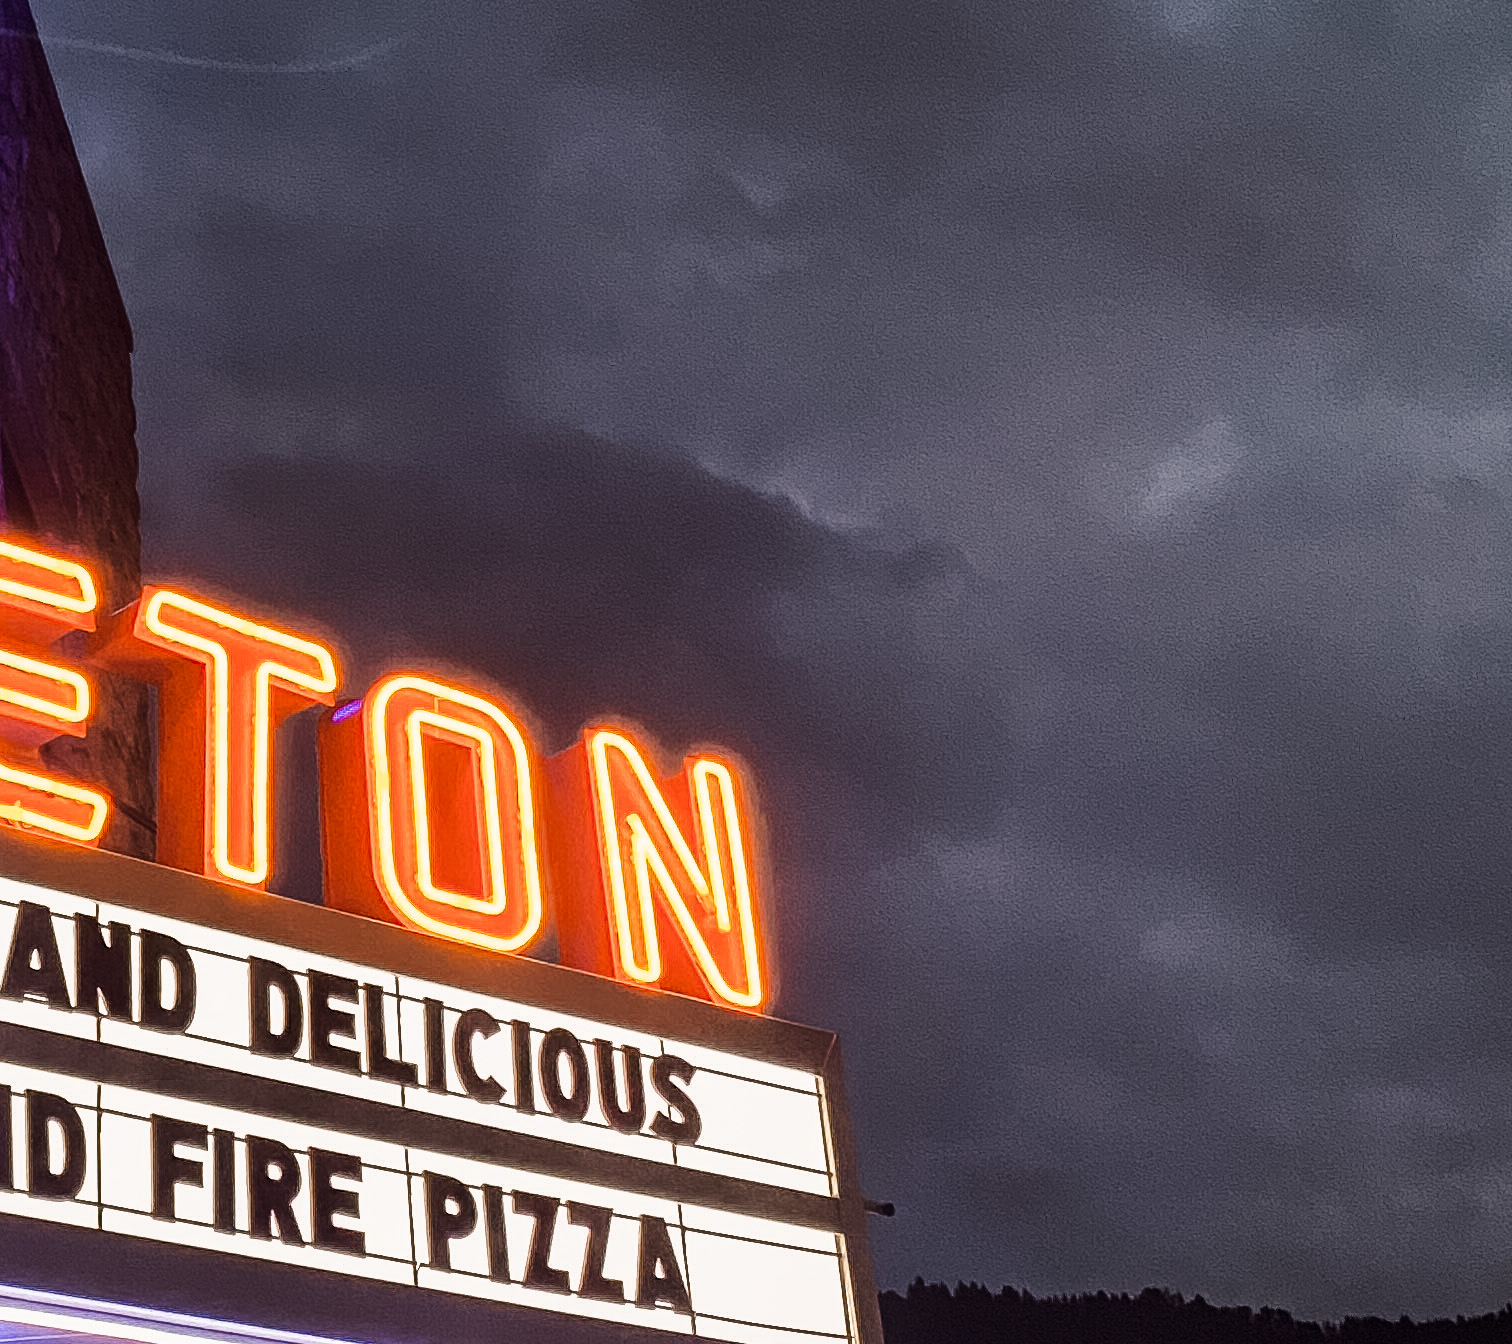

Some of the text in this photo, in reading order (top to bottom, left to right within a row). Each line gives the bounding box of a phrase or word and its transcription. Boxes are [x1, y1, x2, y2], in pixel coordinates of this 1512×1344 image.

[248, 954, 703, 1147] DELICIOUS
[150, 1113, 366, 1258] FIRE
[422, 1169, 694, 1315] PIZZA
